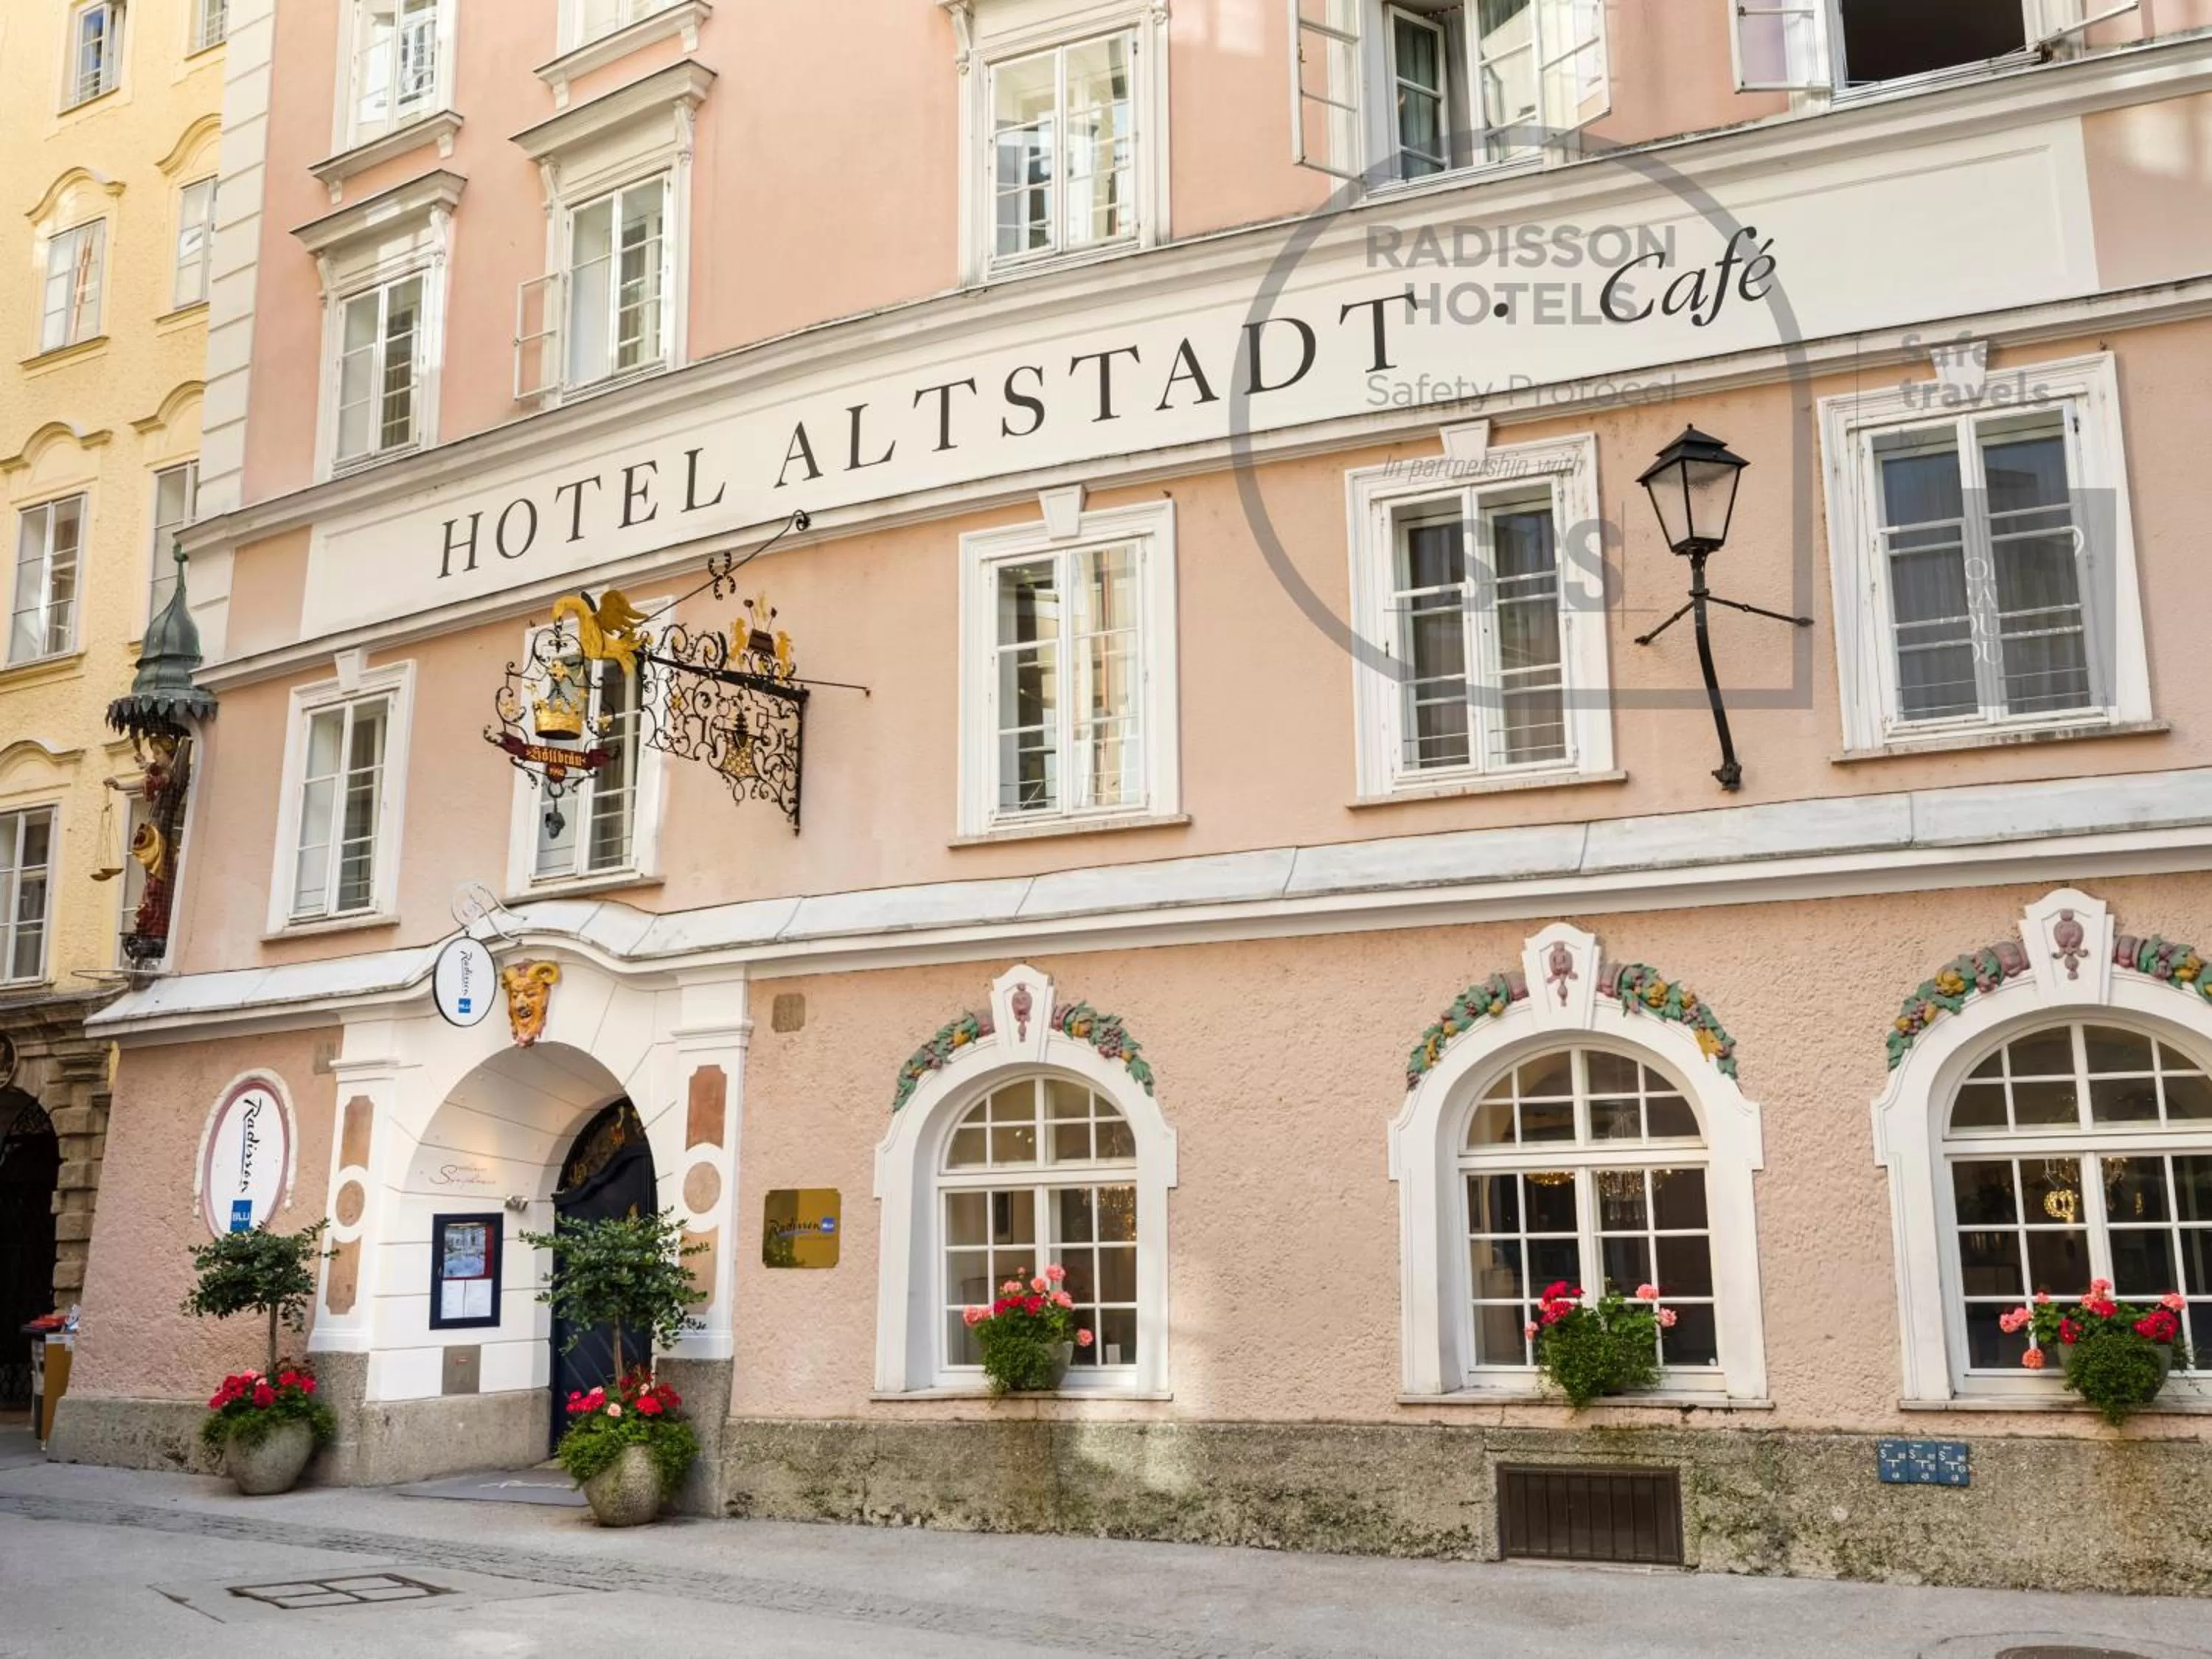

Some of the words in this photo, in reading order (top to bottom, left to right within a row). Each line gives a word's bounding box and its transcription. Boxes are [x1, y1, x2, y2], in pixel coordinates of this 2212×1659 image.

[437, 448, 728, 580] HOTEL
[773, 291, 1419, 488] ALTSTADT
[1599, 226, 1777, 327] Café
[240, 1097, 262, 1192] Radisson
